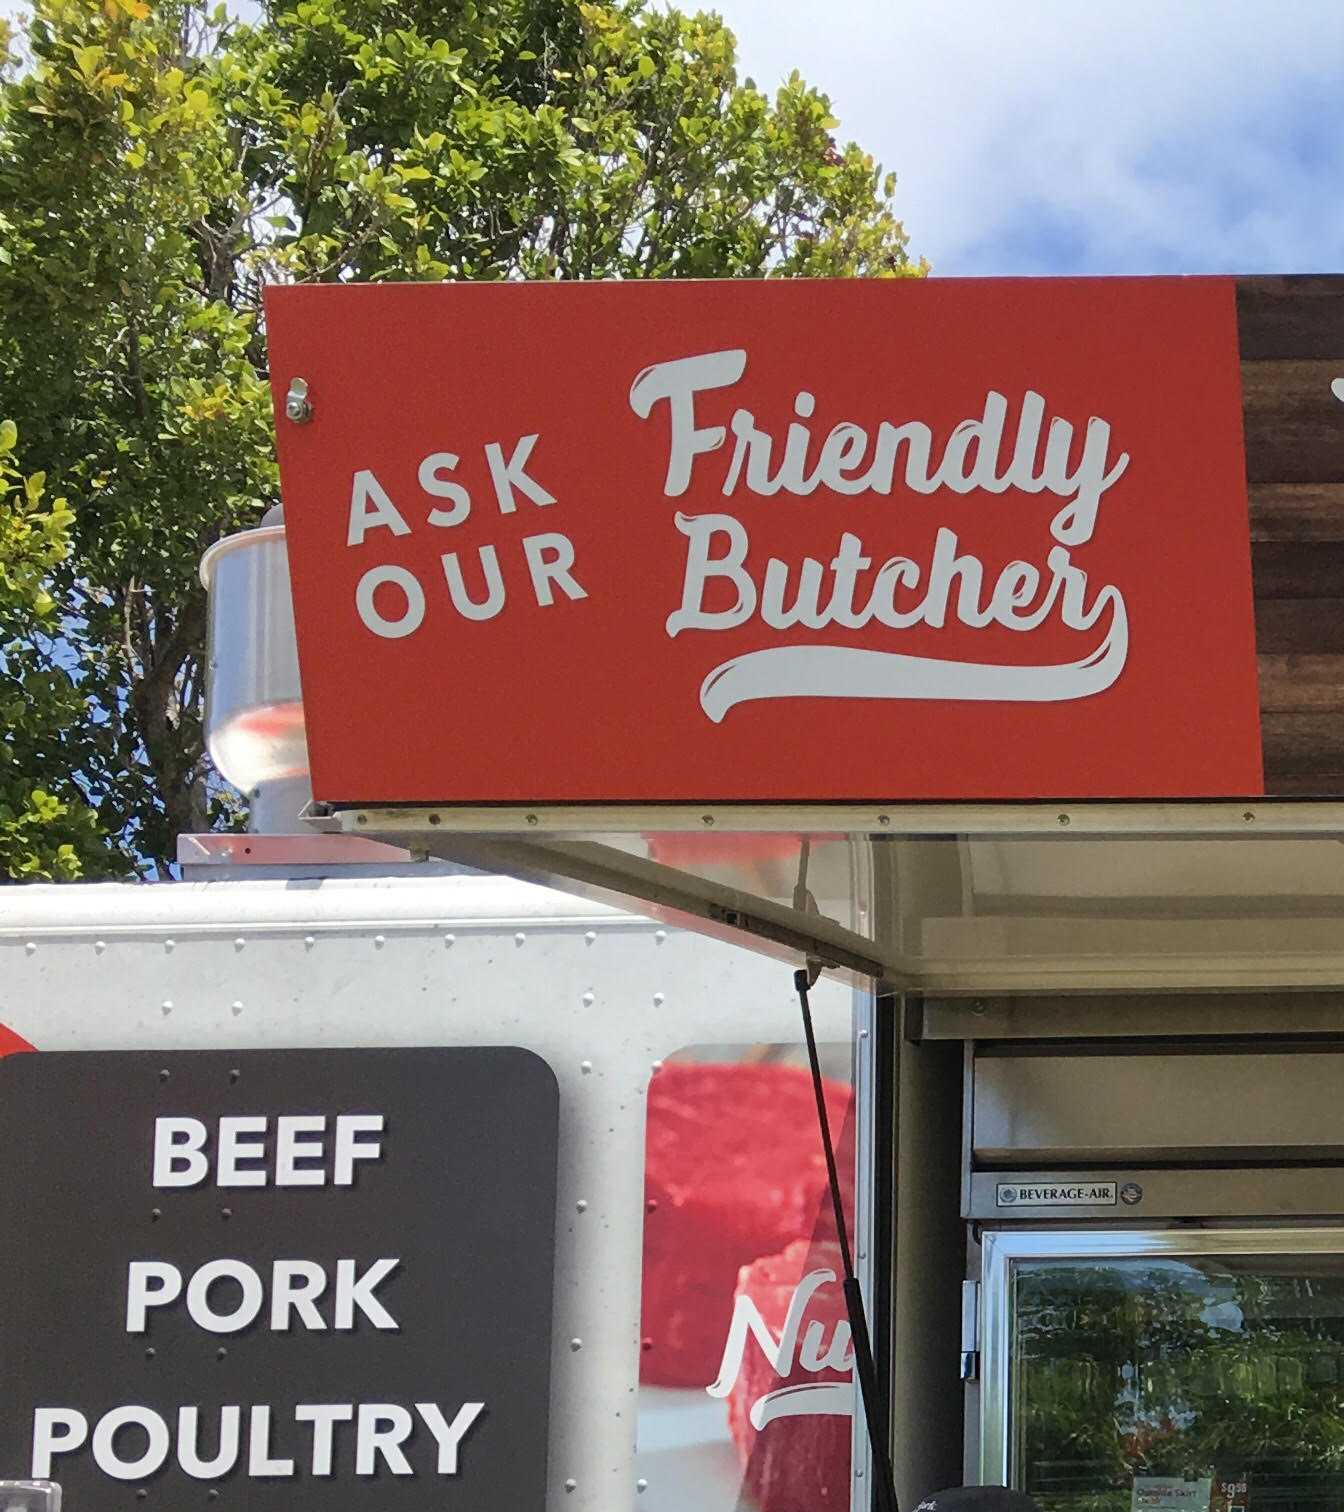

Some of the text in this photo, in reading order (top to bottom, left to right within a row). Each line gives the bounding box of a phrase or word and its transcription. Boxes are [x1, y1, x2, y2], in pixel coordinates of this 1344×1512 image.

[345, 434, 557, 547] ASK
[629, 348, 1130, 546] Friendly
[355, 531, 588, 639] OUR
[666, 510, 1130, 723] Butcher
[153, 1115, 386, 1188] BEEF
[126, 1257, 400, 1333] PORK
[32, 1402, 486, 1480] POULTRY
